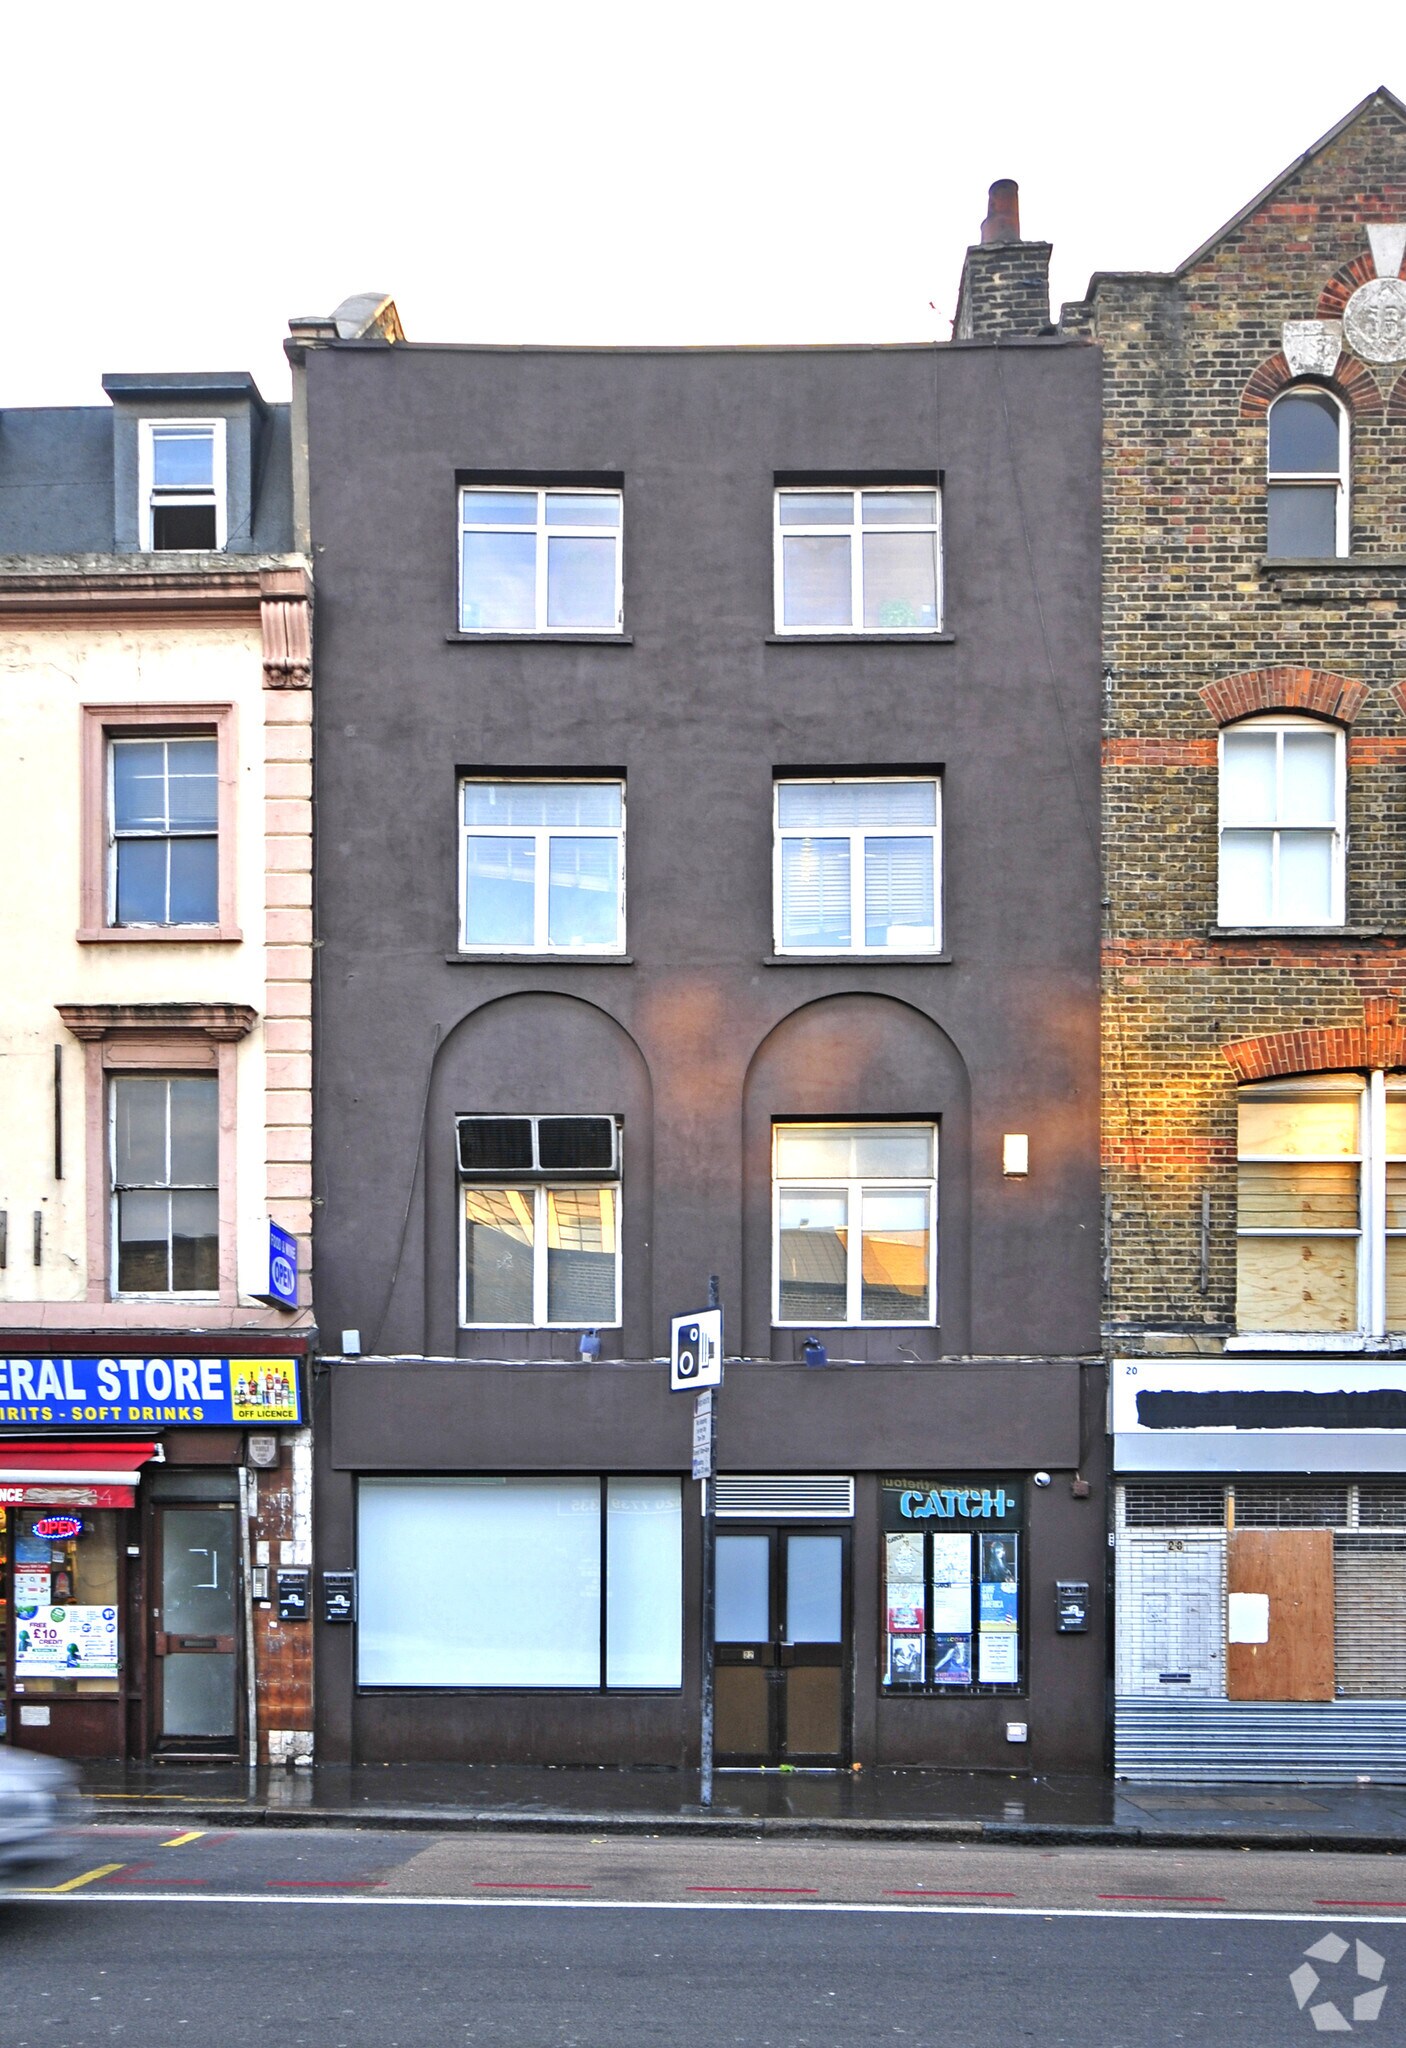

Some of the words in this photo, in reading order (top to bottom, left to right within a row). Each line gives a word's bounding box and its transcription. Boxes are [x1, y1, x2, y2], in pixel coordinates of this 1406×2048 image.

[274, 1261, 293, 1290] OPEN
[1125, 1366, 1138, 1375] 20
[97, 1358, 224, 1402] STORE
[71, 1406, 121, 1421] SOFT
[128, 1406, 205, 1421] DRINKS
[238, 1410, 255, 1418] OFF
[257, 1410, 294, 1418] LICENCE
[0, 1488, 24, 1502] NCE
[37, 1520, 79, 1536] OPEN
[33, 1629, 57, 1639] £10
